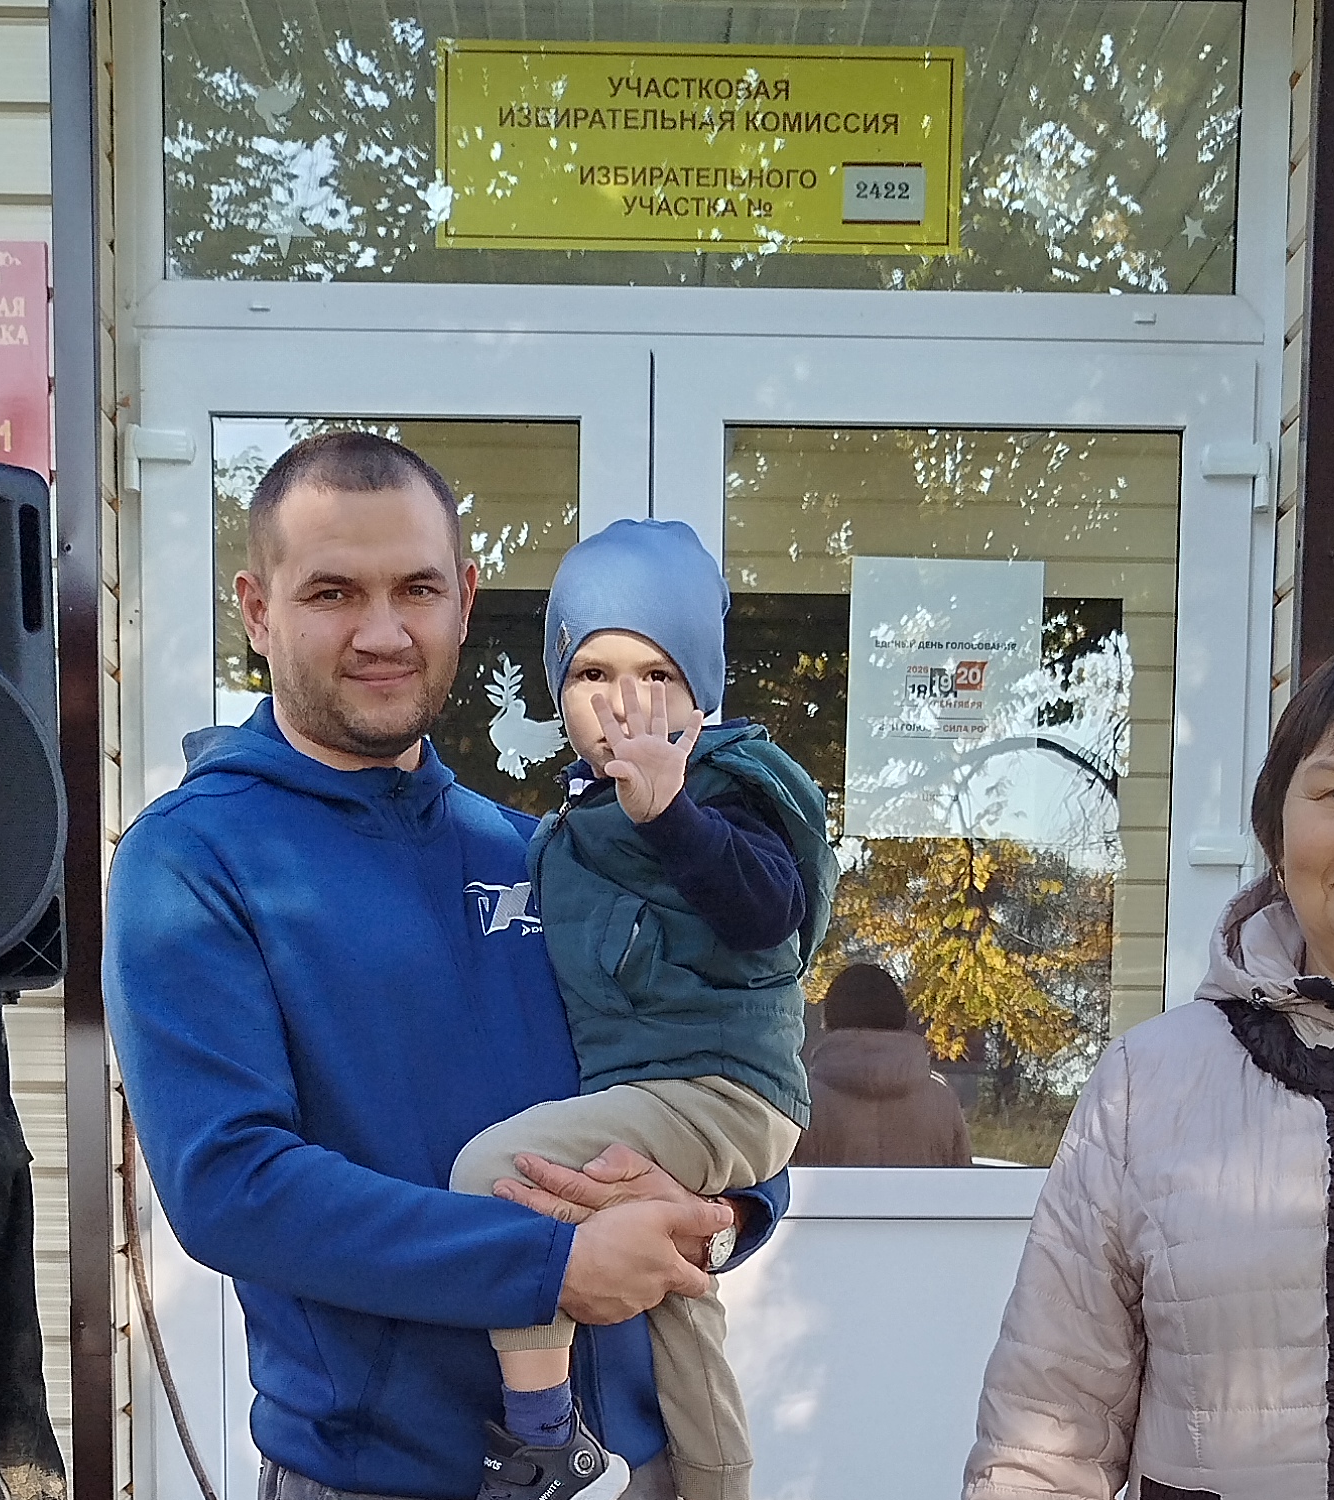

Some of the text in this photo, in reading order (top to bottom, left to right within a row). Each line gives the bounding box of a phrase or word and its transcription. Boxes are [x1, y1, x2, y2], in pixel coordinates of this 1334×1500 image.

[607, 76, 790, 101] УЧАСТКОВАЯ
[498, 106, 899, 135] ИЗБИРАТЕЛЬНАЯ КОМИССИЯ
[579, 166, 817, 190] ИЗБИРАТЕЛЬНОГО
[856, 181, 910, 200] 2422
[622, 196, 773, 218] УЧАСТКА №
[918, 640, 944, 650] ДЕНЬ
[956, 667, 982, 685] 20
[943, 724, 969, 733] СИЛА
